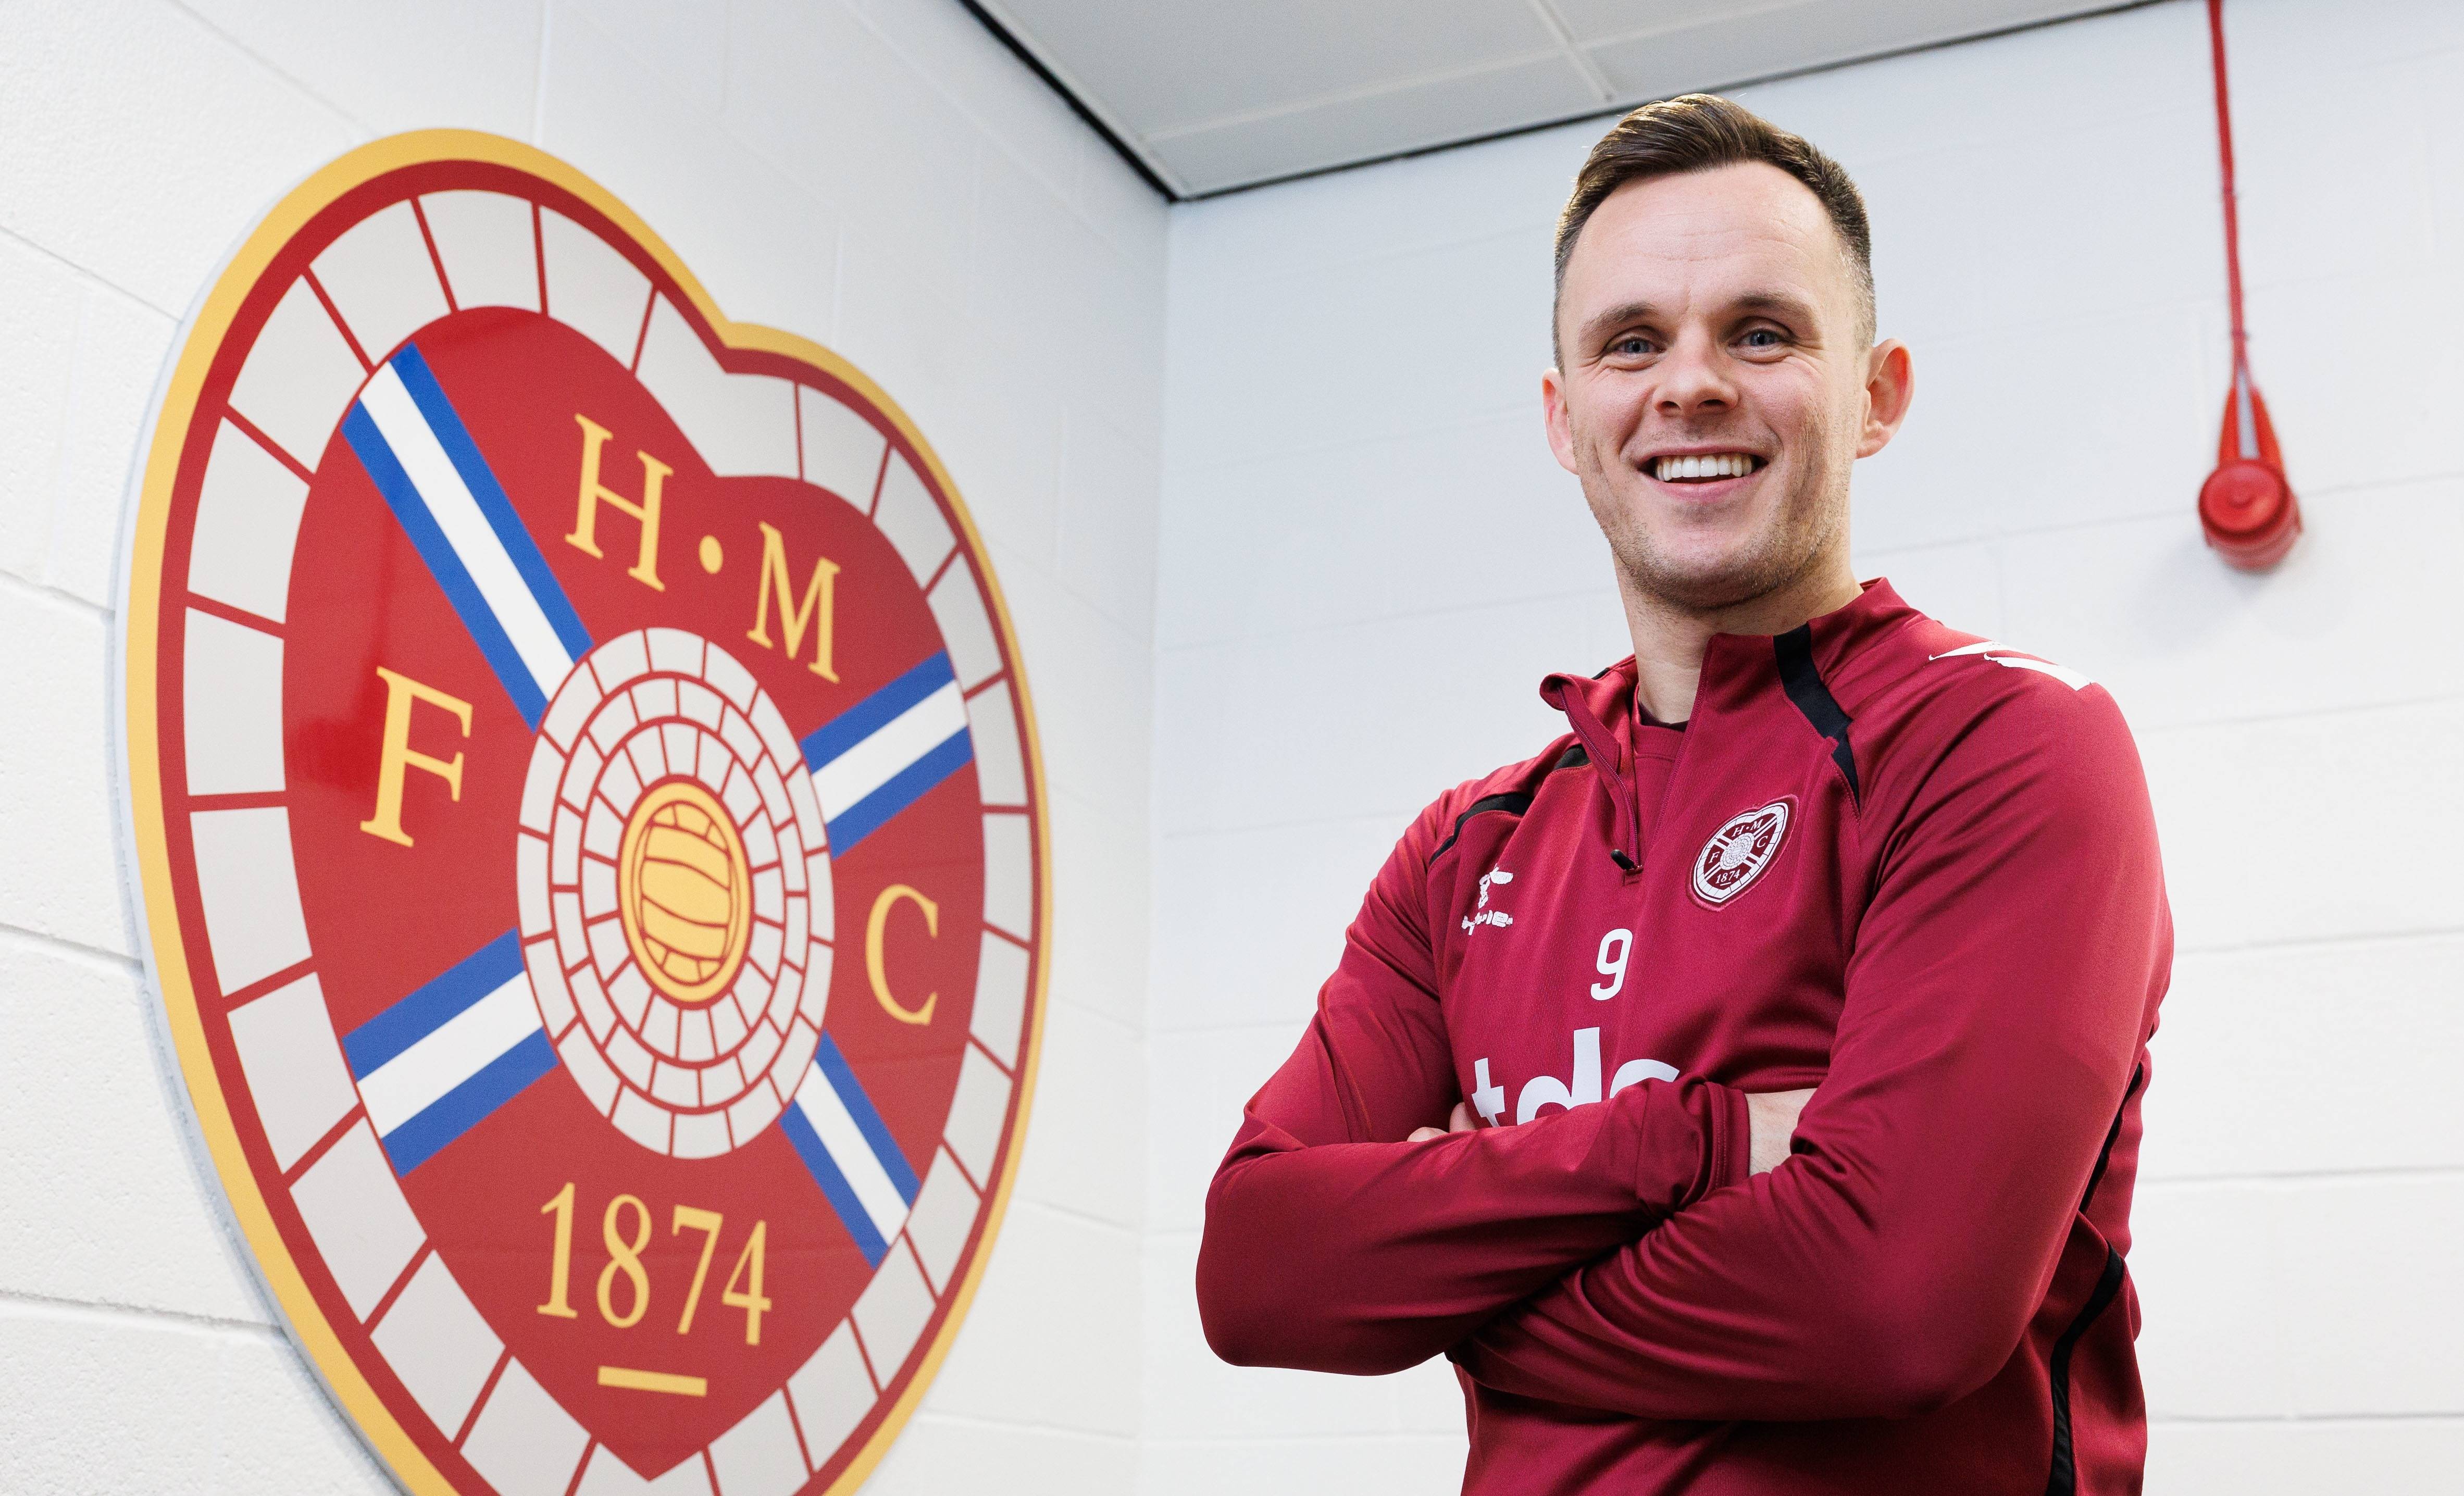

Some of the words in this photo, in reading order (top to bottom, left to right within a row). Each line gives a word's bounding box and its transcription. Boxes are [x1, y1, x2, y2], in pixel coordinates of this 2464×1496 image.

[359, 665, 474, 849] F
[1708, 851, 1720, 864] F
[1715, 869, 1740, 884] 1874
[1757, 836, 1768, 848] C
[864, 883, 939, 1026] C
[1590, 928, 1634, 1001] 9
[536, 1181, 773, 1346] 1874
